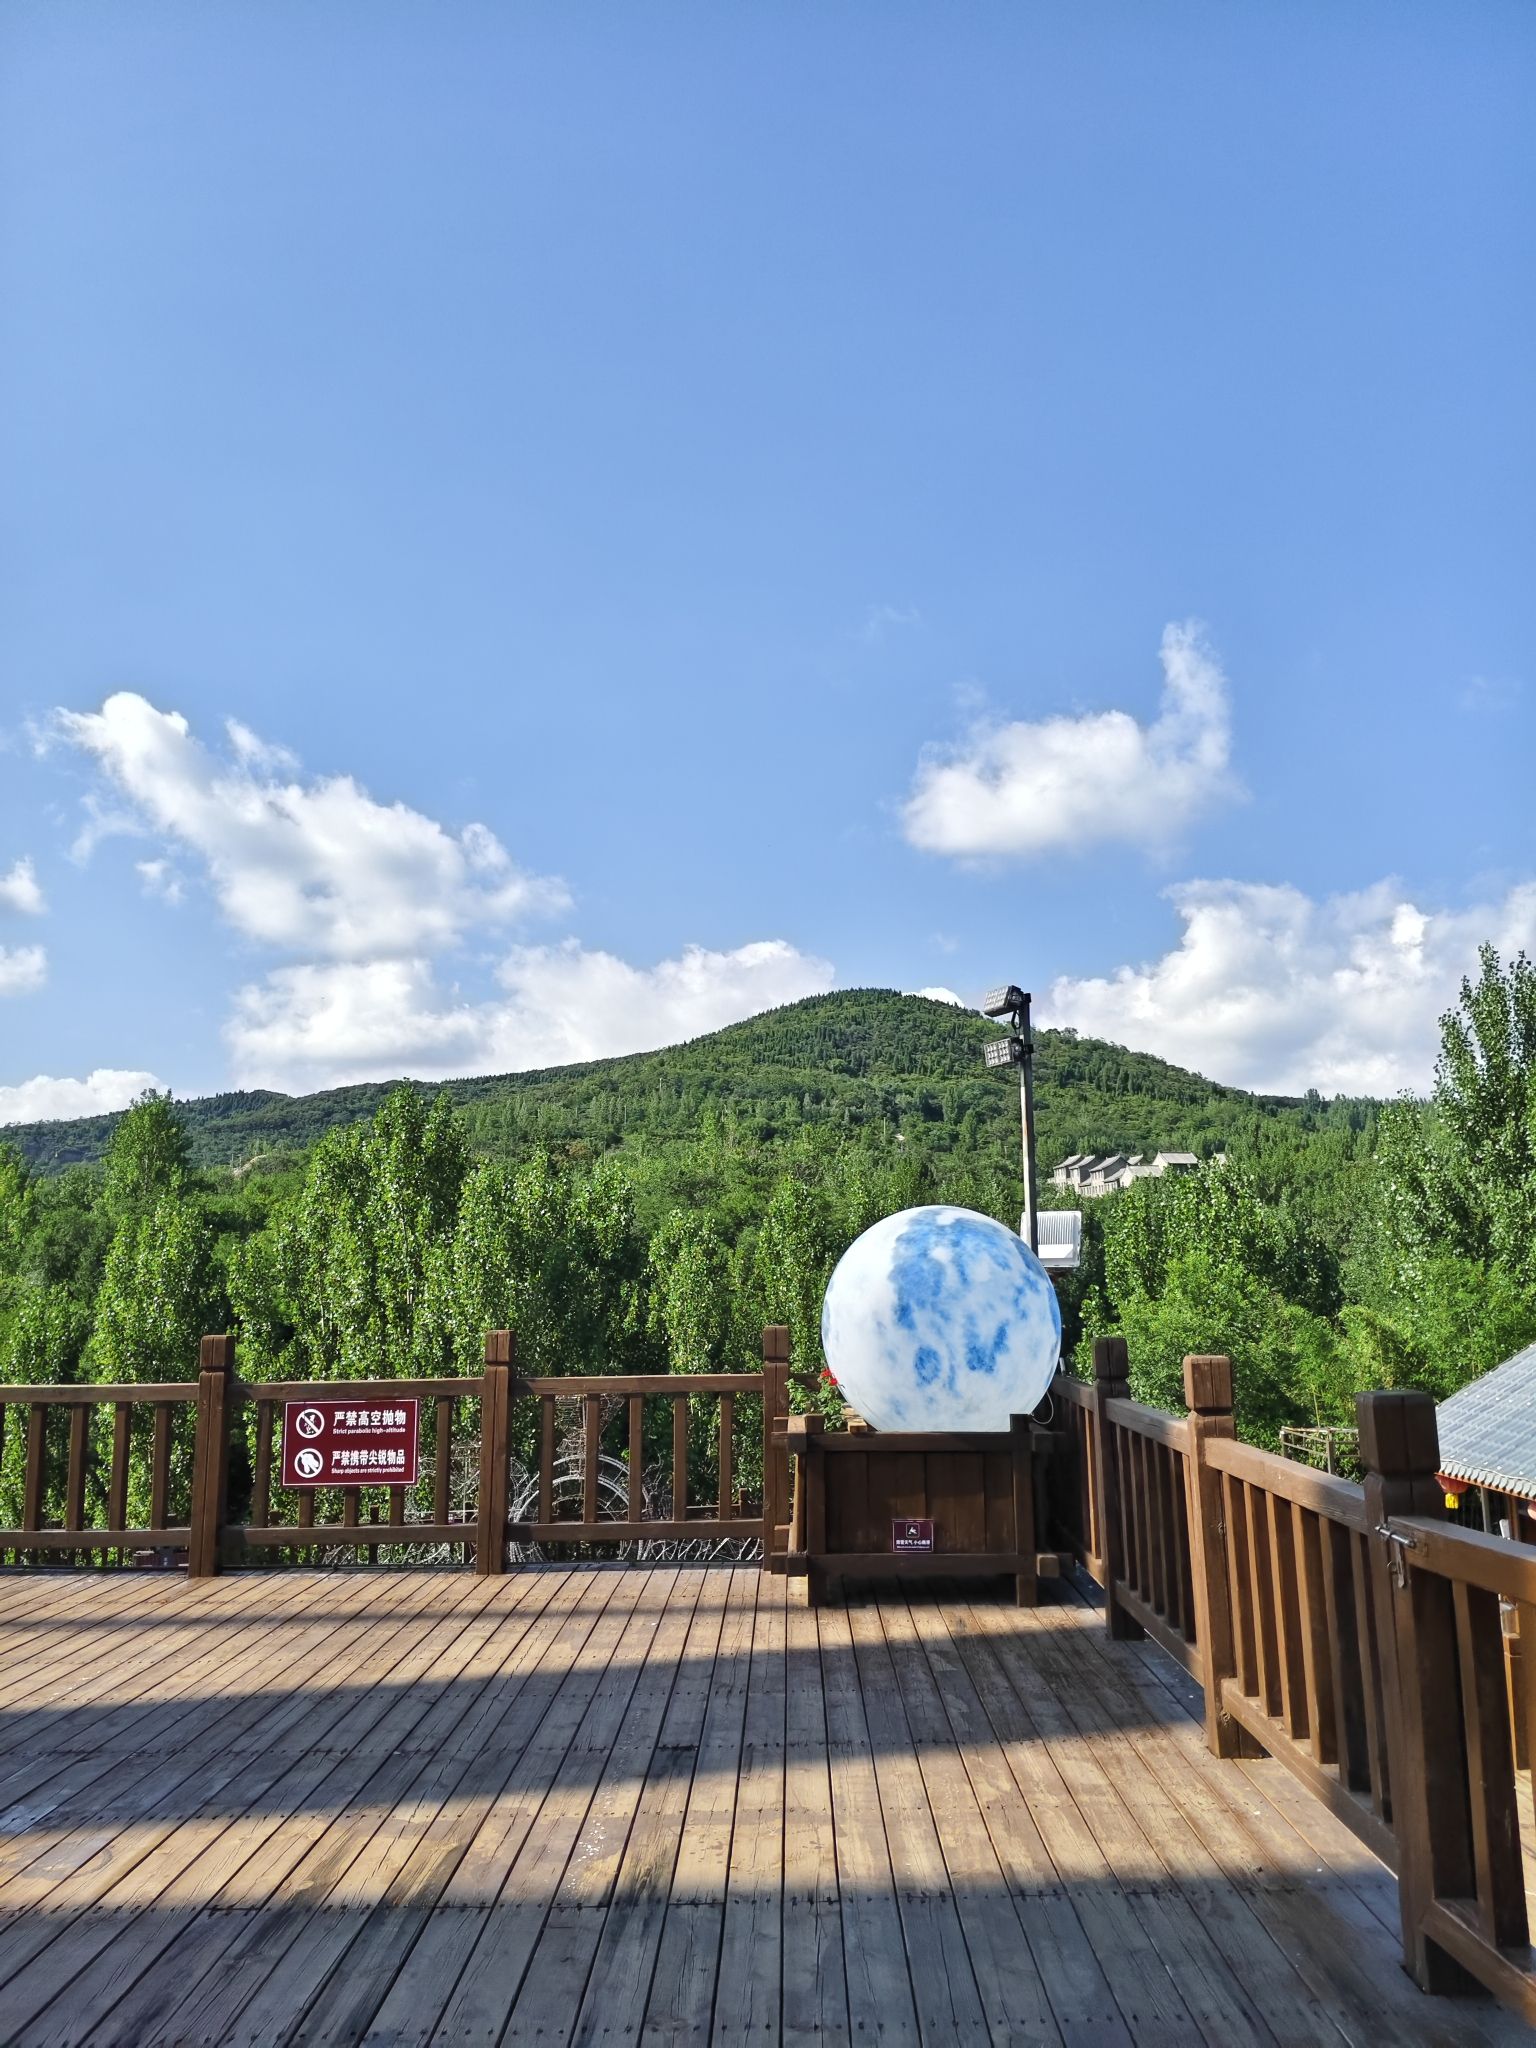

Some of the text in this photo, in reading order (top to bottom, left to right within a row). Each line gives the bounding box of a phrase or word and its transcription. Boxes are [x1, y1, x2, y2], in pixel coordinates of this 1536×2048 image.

[333, 1410, 406, 1426] 严禁高空抛物
[331, 1449, 405, 1466] 严禁携带尖锐物品
